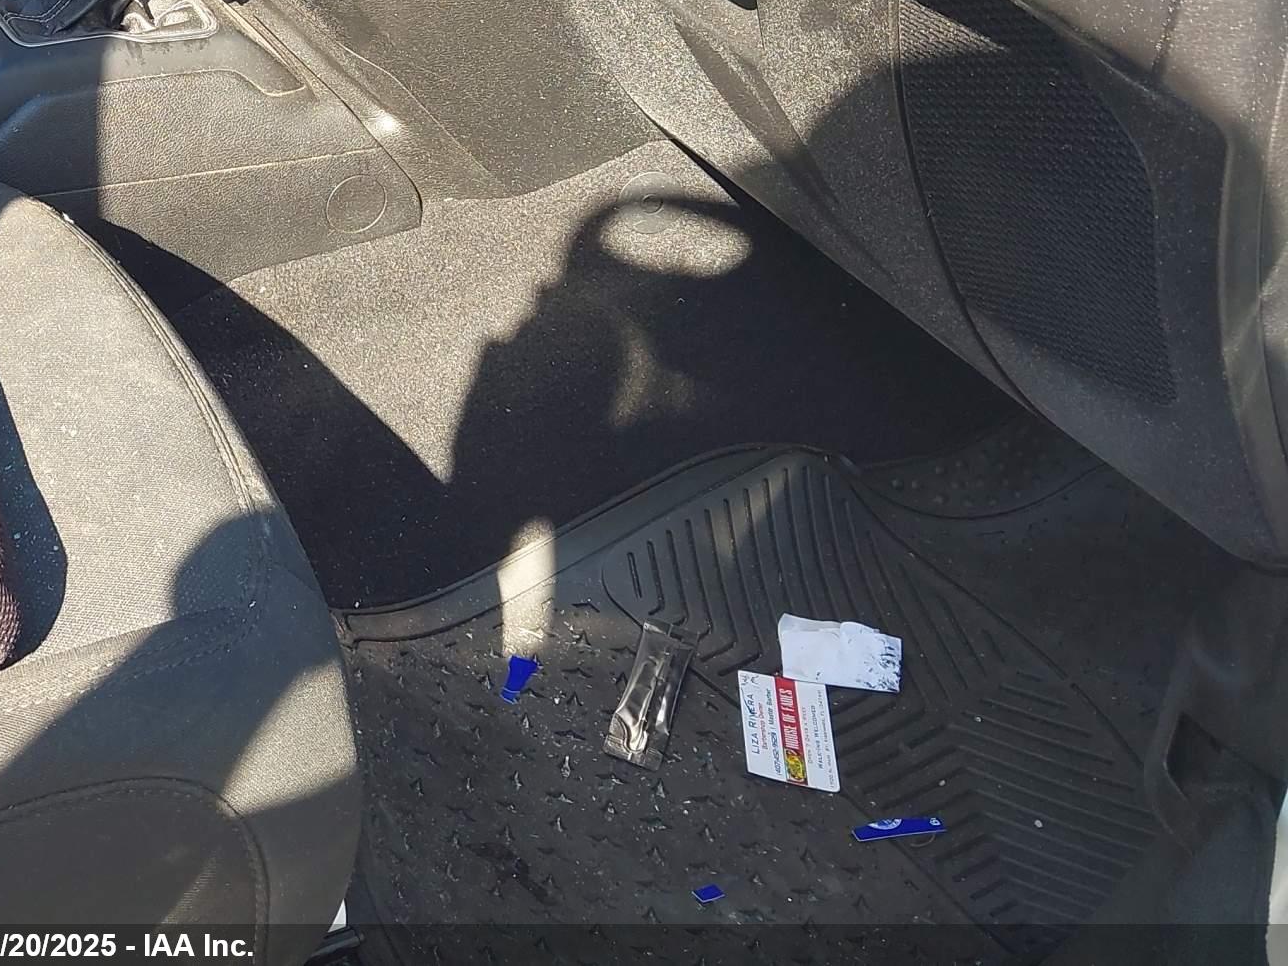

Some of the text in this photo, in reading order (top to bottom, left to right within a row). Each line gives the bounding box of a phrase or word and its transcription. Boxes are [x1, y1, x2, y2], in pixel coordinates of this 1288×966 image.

[746, 693, 758, 728] RIVERA
[779, 689, 799, 749] HOUSE OF FADES
[750, 733, 760, 754] LIZA
